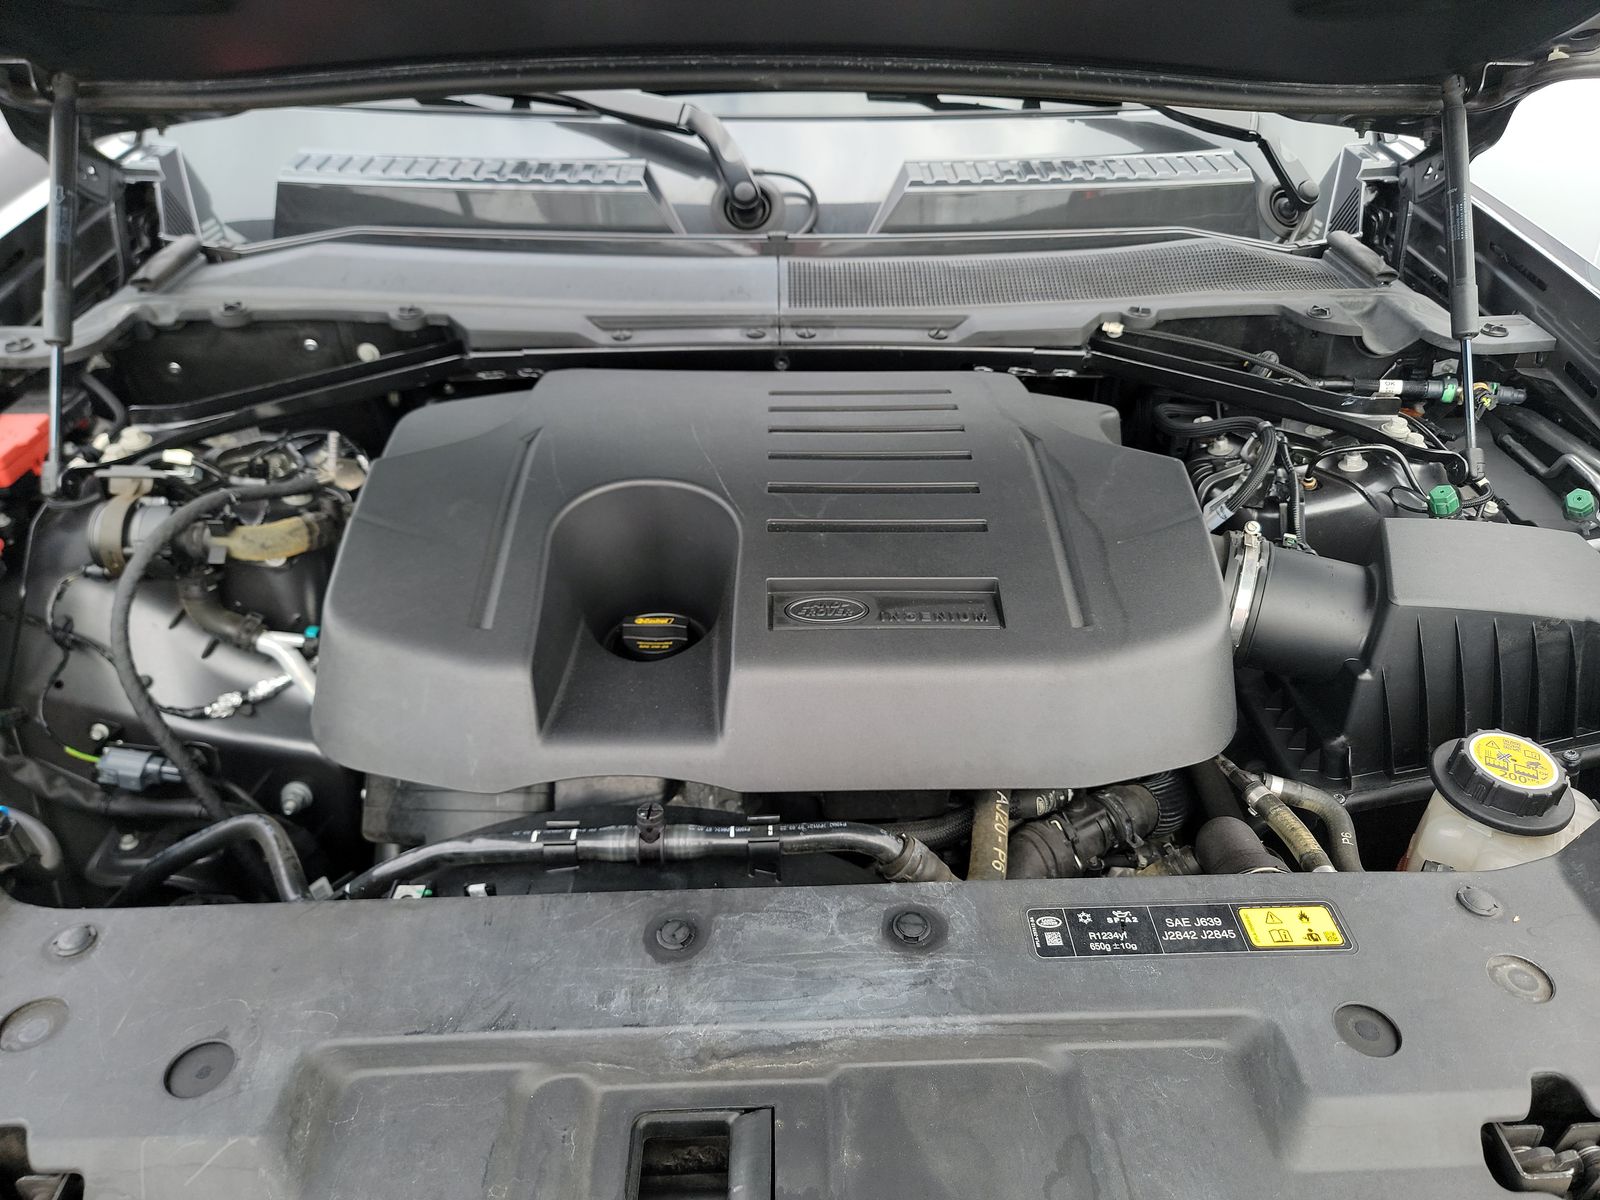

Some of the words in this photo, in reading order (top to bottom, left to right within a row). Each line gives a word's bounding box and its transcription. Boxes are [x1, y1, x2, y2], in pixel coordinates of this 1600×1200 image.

[879, 610, 989, 623] INGENIUM
[1340, 831, 1354, 846] P6
[1106, 916, 1139, 924] SP-A2
[1165, 918, 1191, 927] SAE
[1194, 917, 1222, 927] J639
[1088, 931, 1128, 940] R1234yf
[1162, 930, 1198, 940] J2842
[1201, 930, 1236, 940] J2845
[1090, 942, 1111, 951] 650g
